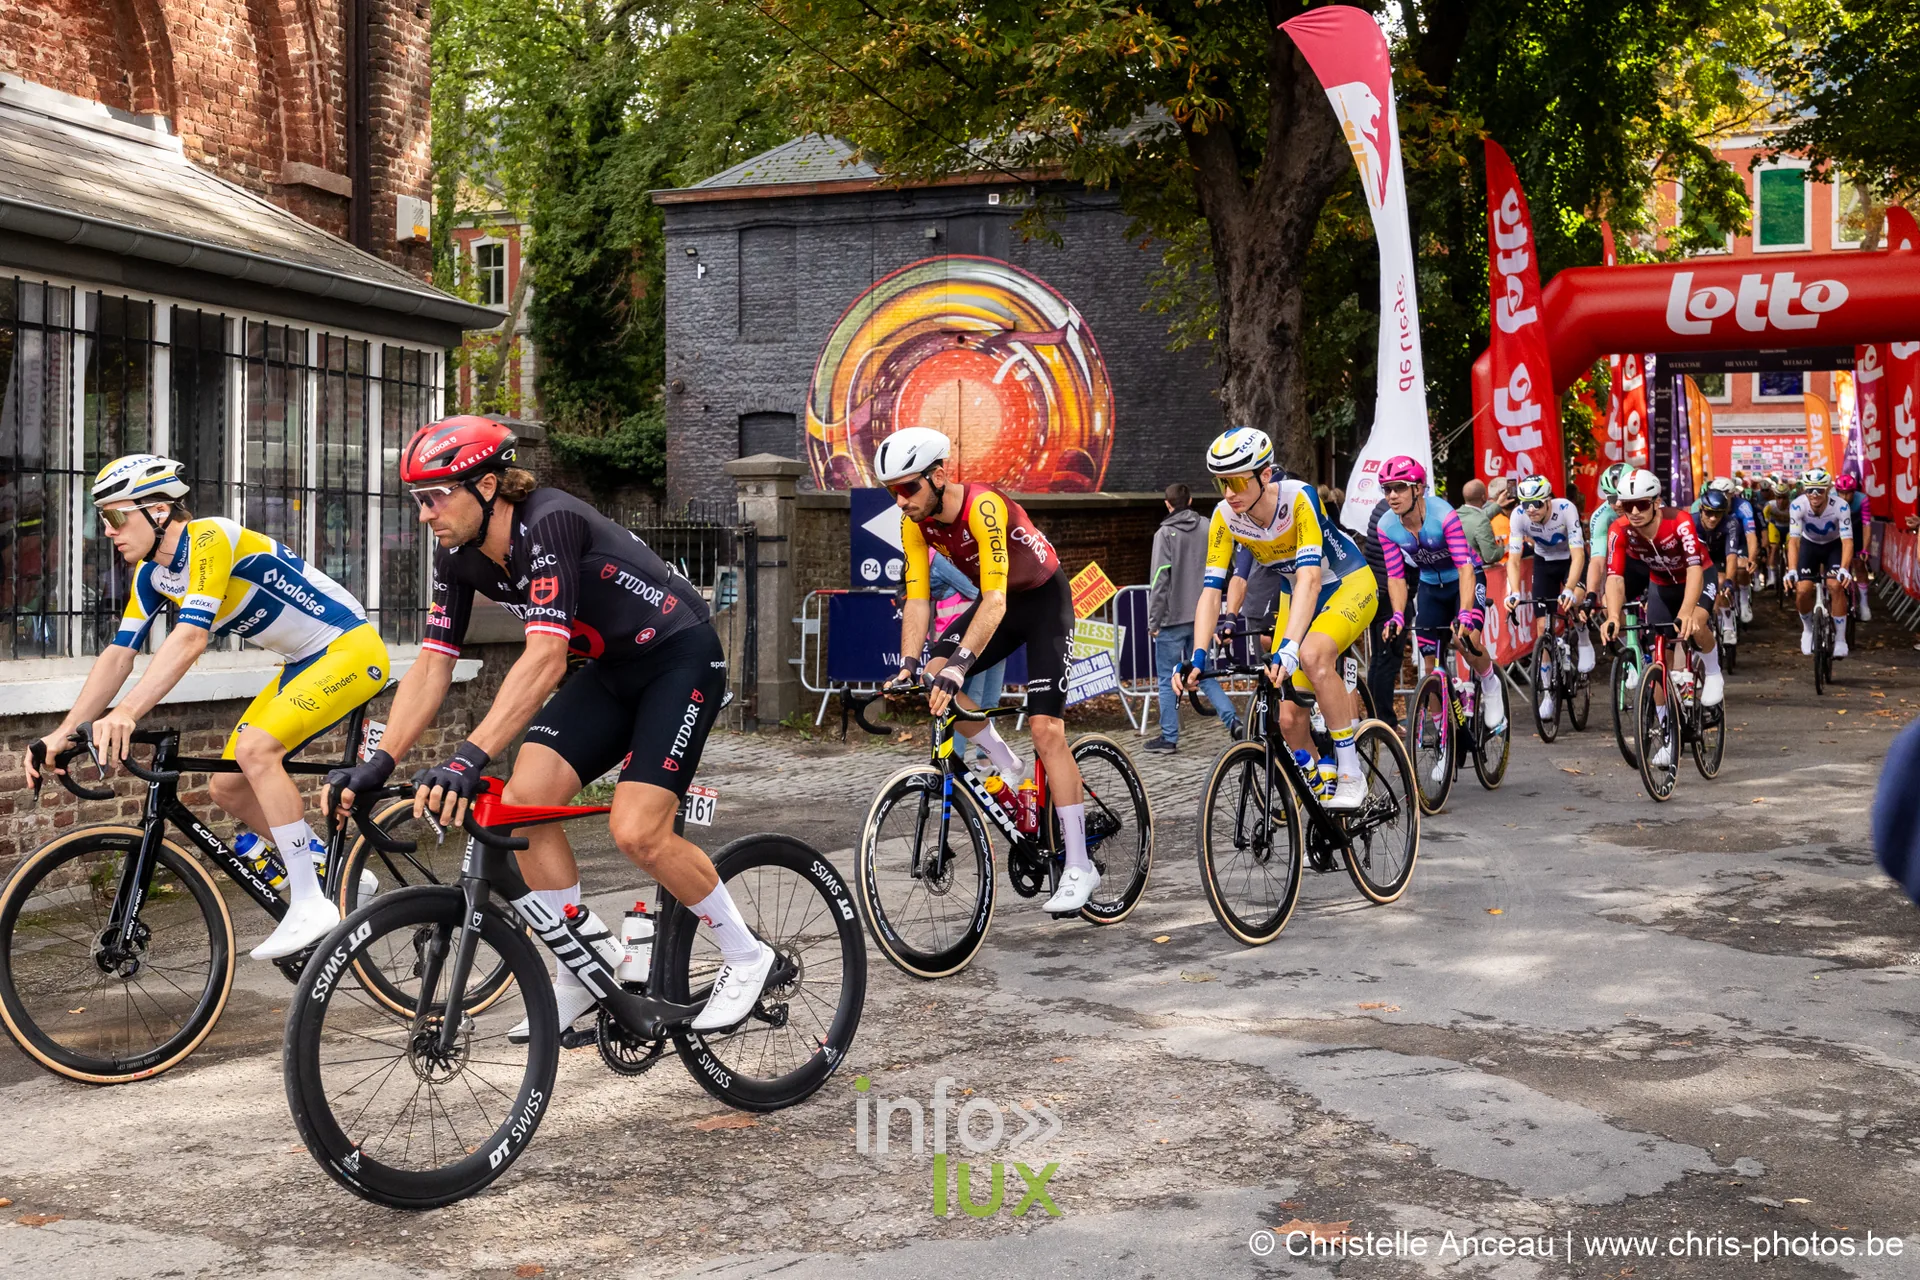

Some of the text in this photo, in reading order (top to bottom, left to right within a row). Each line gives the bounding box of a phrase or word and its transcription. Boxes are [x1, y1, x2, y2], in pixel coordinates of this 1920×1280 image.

[424, 439, 451, 458] TUDOR
[450, 445, 495, 473] OAKLEY
[979, 500, 1007, 564] Cofidis
[1010, 525, 1048, 564] Cofidis
[1327, 533, 1348, 560] baloise
[197, 558, 207, 592] Flanders
[433, 580, 448, 591] SC
[863, 563, 879, 575] P4
[1083, 565, 1099, 583] VIP
[274, 575, 326, 617] baloise
[614, 570, 665, 607] TUDOR
[231, 607, 268, 635] loise
[1058, 628, 1075, 693] Cofidis
[1346, 663, 1357, 685] 135
[313, 674, 336, 689] Team
[322, 672, 358, 697] Flanders
[670, 703, 700, 759] TUDOR
[687, 797, 714, 823] 161
[963, 772, 1026, 845] LOOK
[192, 822, 278, 903] eddy merckx
[810, 860, 854, 921] DT SWISS
[312, 920, 373, 1003] DT SWISS
[509, 891, 623, 999] BMC
[698, 1052, 733, 1090] SWISS
[487, 1088, 544, 1170] DT SWISS
